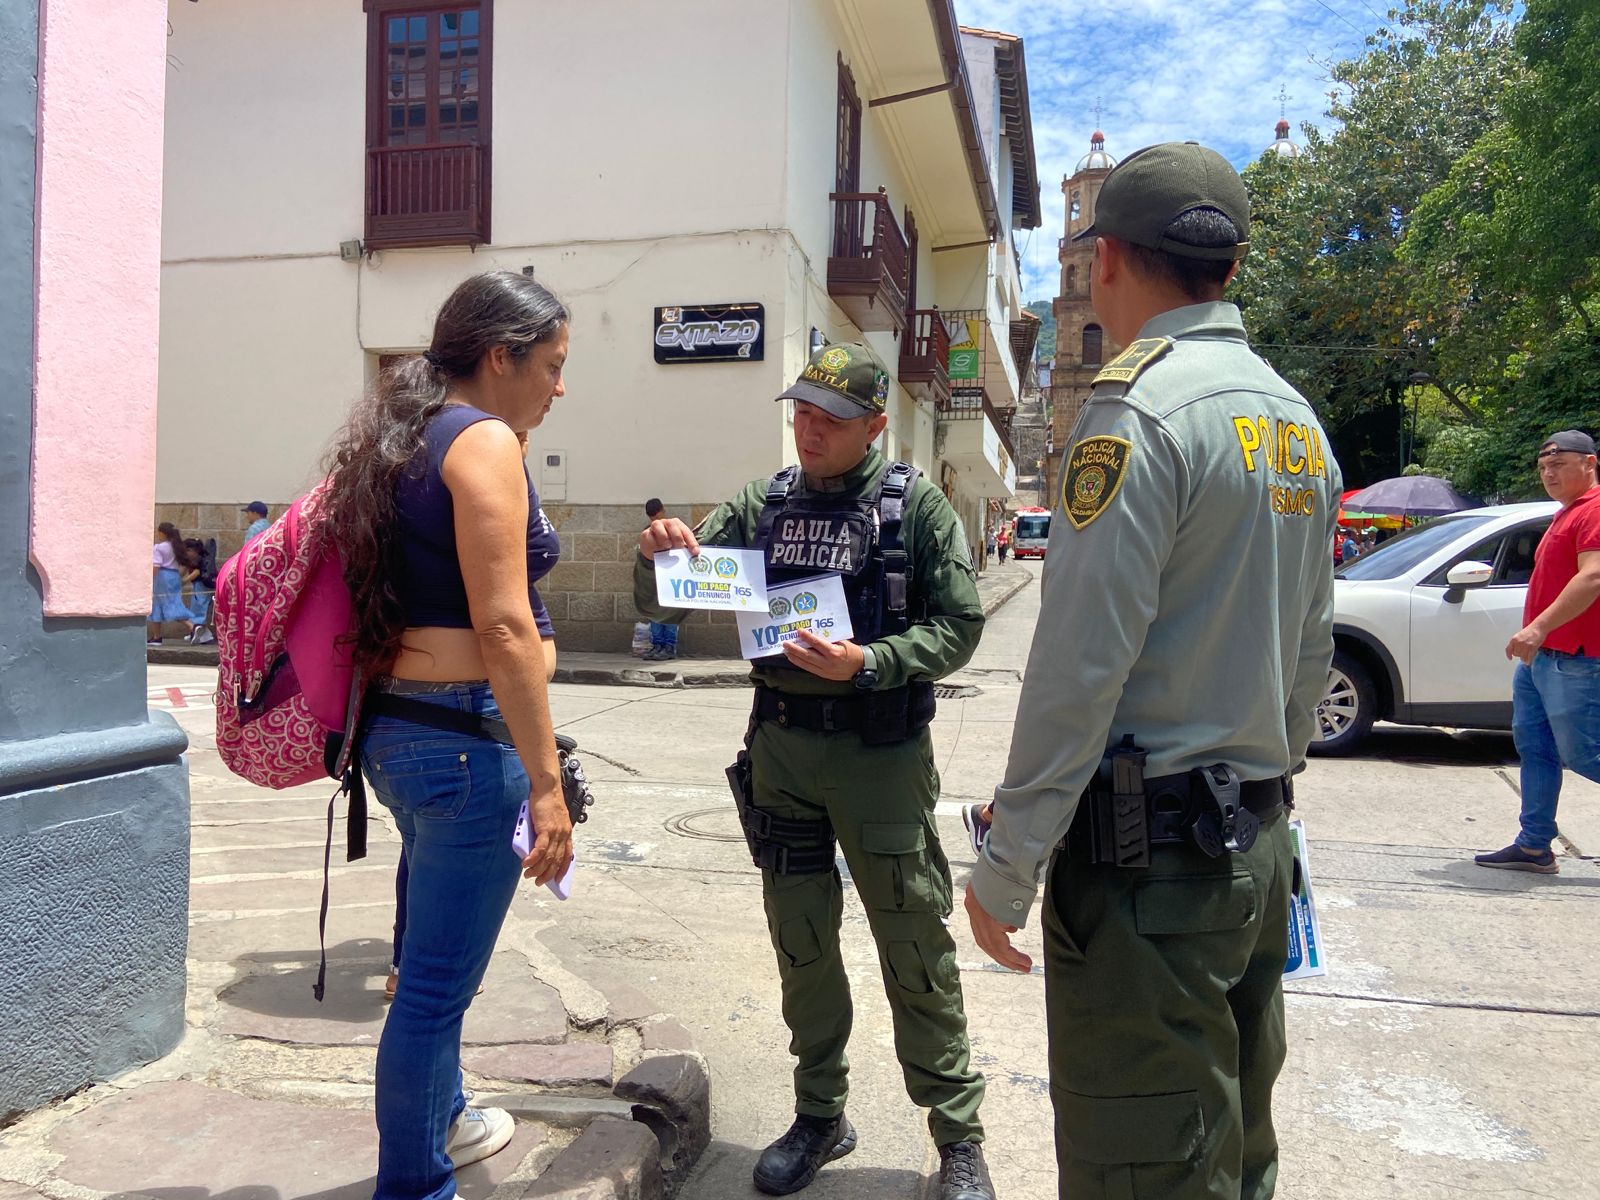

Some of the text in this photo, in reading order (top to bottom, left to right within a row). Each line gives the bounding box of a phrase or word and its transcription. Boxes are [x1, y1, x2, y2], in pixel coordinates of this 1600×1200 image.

[805, 365, 849, 392] GAULA
[1082, 441, 1117, 456] POLICÍA
[1232, 415, 1327, 480] POICIA
[1072, 453, 1120, 469] NACIONAL
[782, 519, 851, 544] GAULA
[770, 543, 853, 571] POLICIA
[670, 579, 697, 598] YO
[698, 582, 729, 591] NO PAGO
[734, 586, 752, 596] 165
[698, 591, 731, 599] DENUNCIO
[780, 619, 811, 633] NO PAGO
[815, 618, 834, 628] 165
[752, 625, 779, 647] YO
